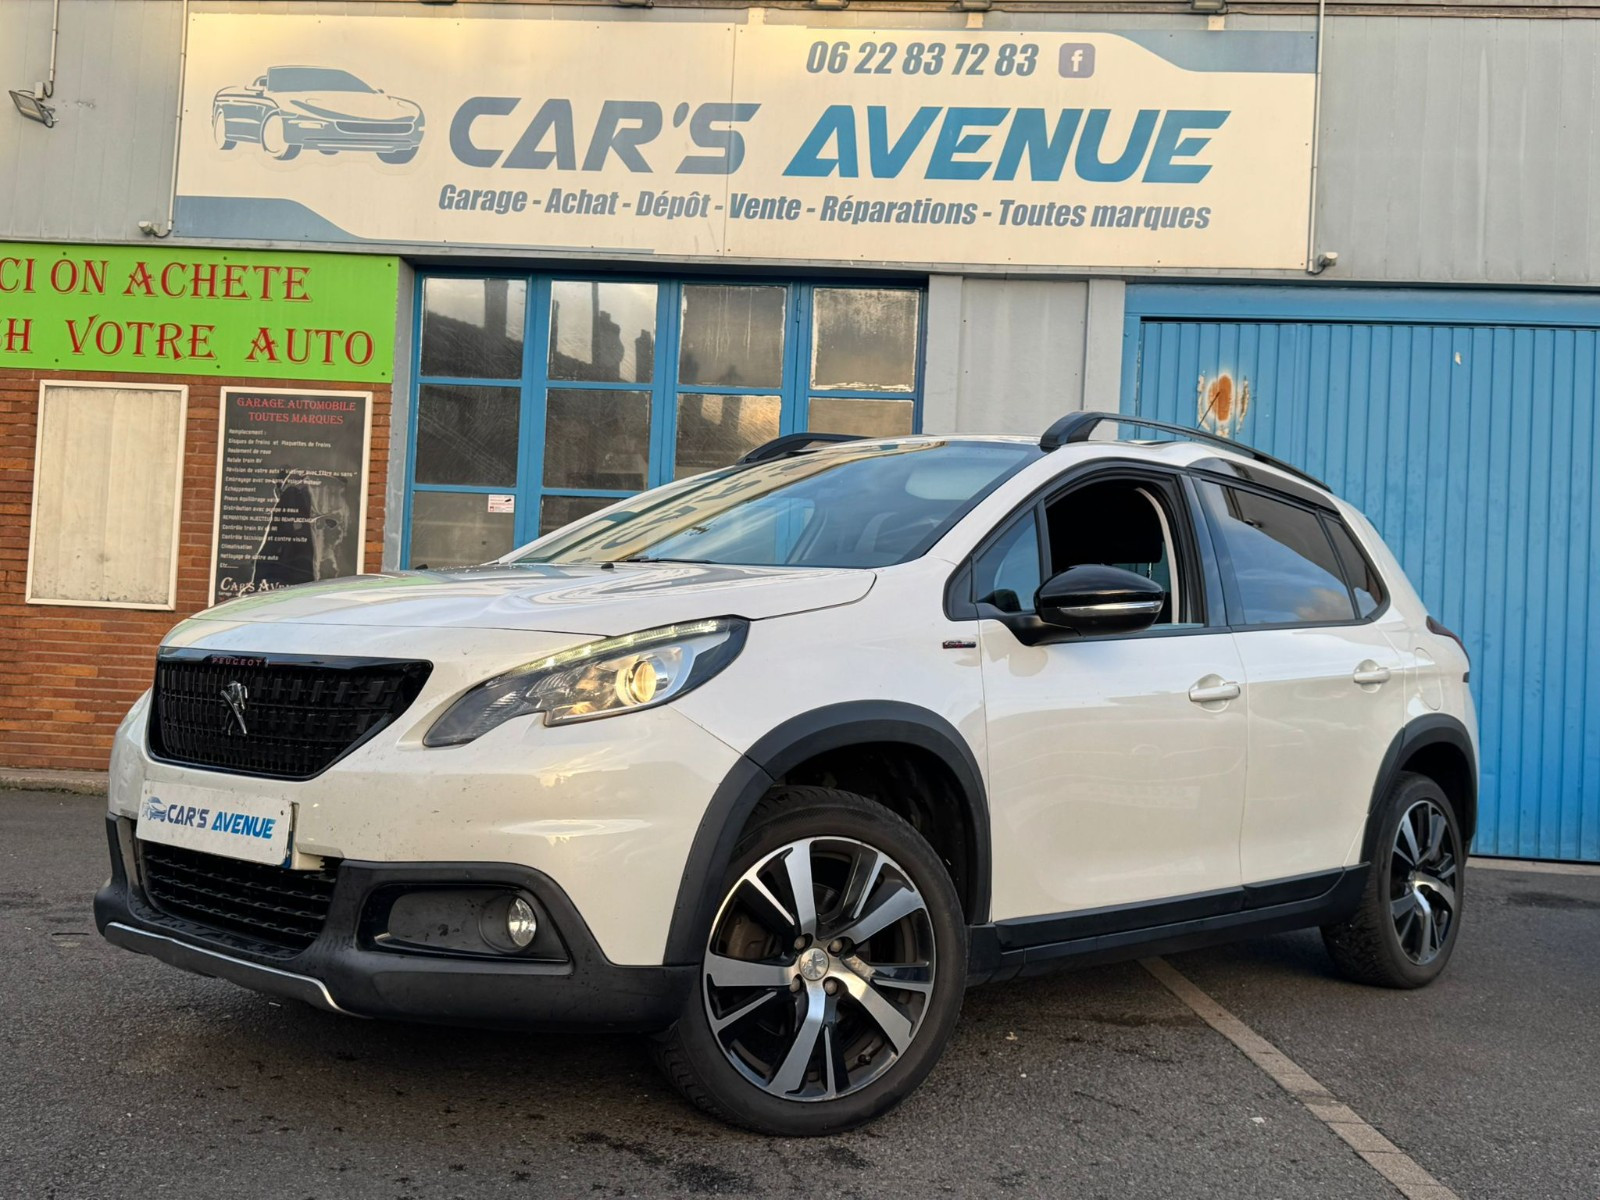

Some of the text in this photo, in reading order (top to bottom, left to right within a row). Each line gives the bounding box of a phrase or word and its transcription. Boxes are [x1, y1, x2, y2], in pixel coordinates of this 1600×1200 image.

[806, 41, 1039, 76] 06 22 83 72 83
[449, 97, 1232, 184] CAR'S AVENUE
[439, 184, 528, 214] Garage
[545, 188, 619, 215] Achat
[635, 190, 711, 219] Dépôt
[729, 193, 800, 221] Vente
[820, 195, 977, 225] Réparations
[999, 200, 1085, 227] Toutes
[1091, 203, 1211, 231] marques
[50, 259, 109, 296] ON
[123, 262, 312, 302] ACHETE
[0, 314, 374, 366] H VOTRE AUTO
[237, 397, 356, 411] GARAGE AUTOMOBILE
[248, 412, 344, 424] TOUTES MARQUES
[212, 657, 261, 666] PEUGEOT
[167, 804, 276, 839] CAR'S AVENUE
